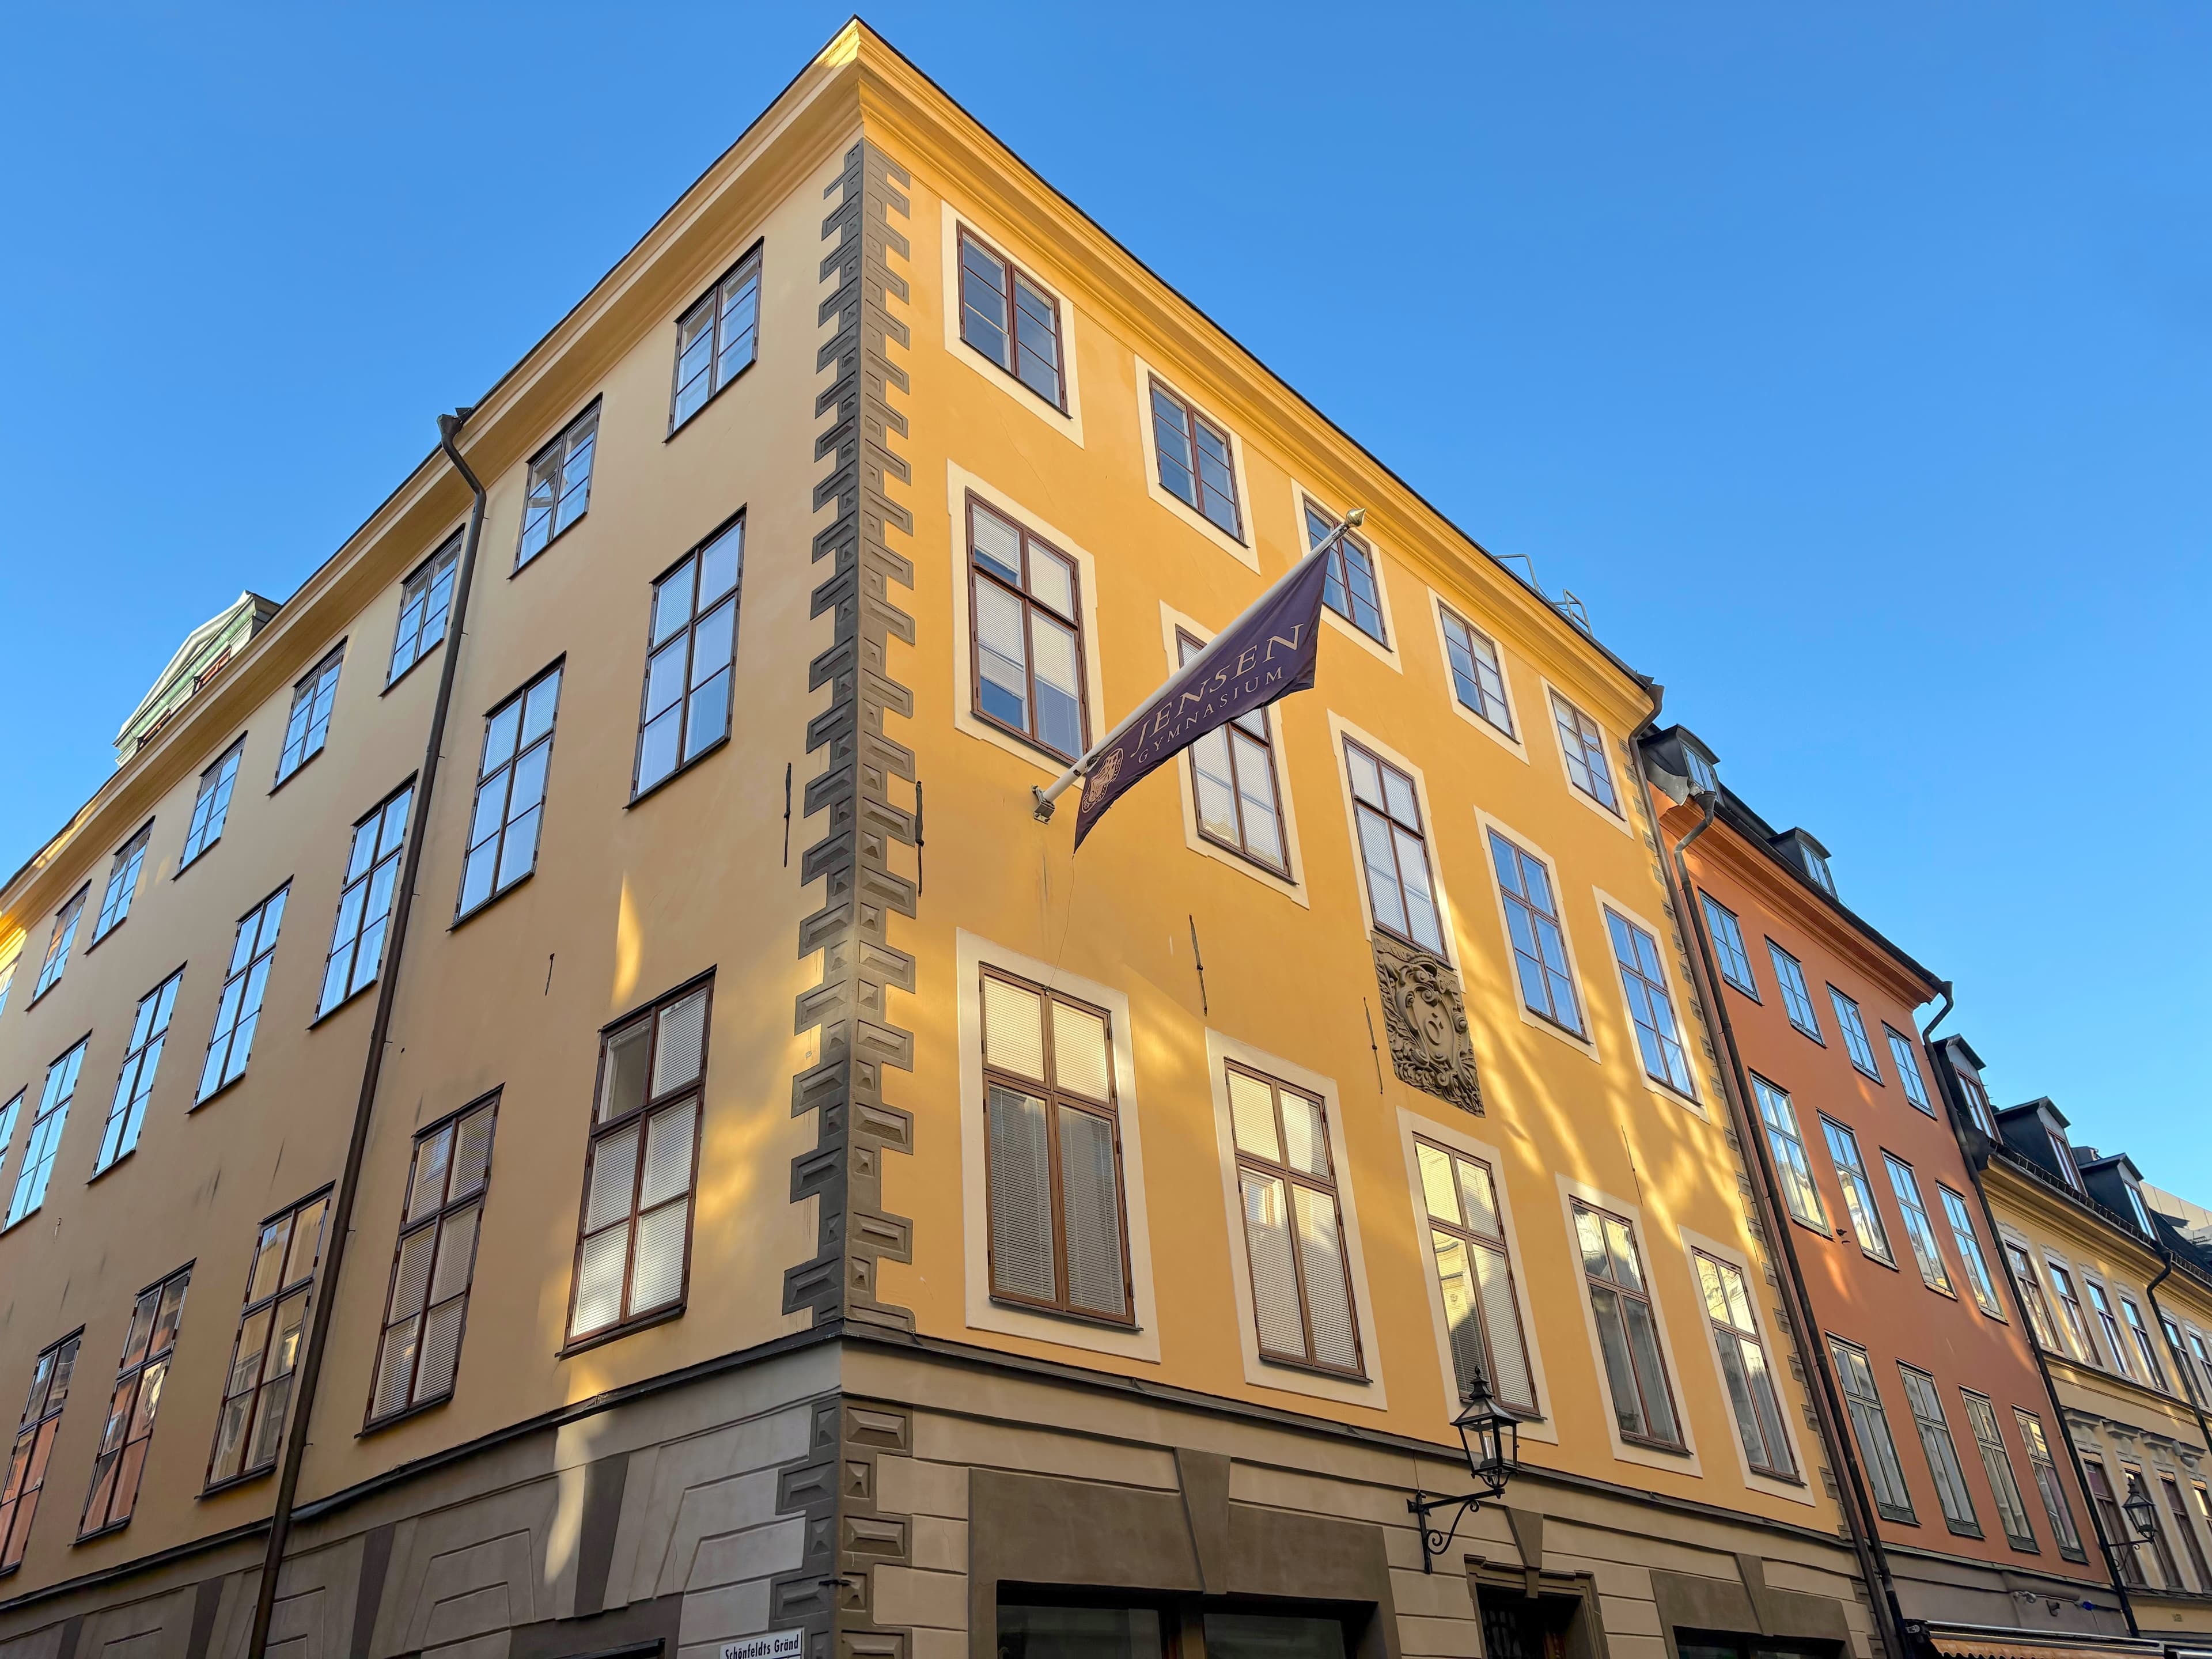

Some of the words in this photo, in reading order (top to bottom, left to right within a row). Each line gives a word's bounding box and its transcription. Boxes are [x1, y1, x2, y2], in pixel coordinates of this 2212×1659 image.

[1130, 623, 1304, 758] JENSEN
[1138, 666, 1283, 763] GYMNASIUM
[725, 1641, 771, 1659] Schönfeldts
[774, 1634, 799, 1653] Gränd
